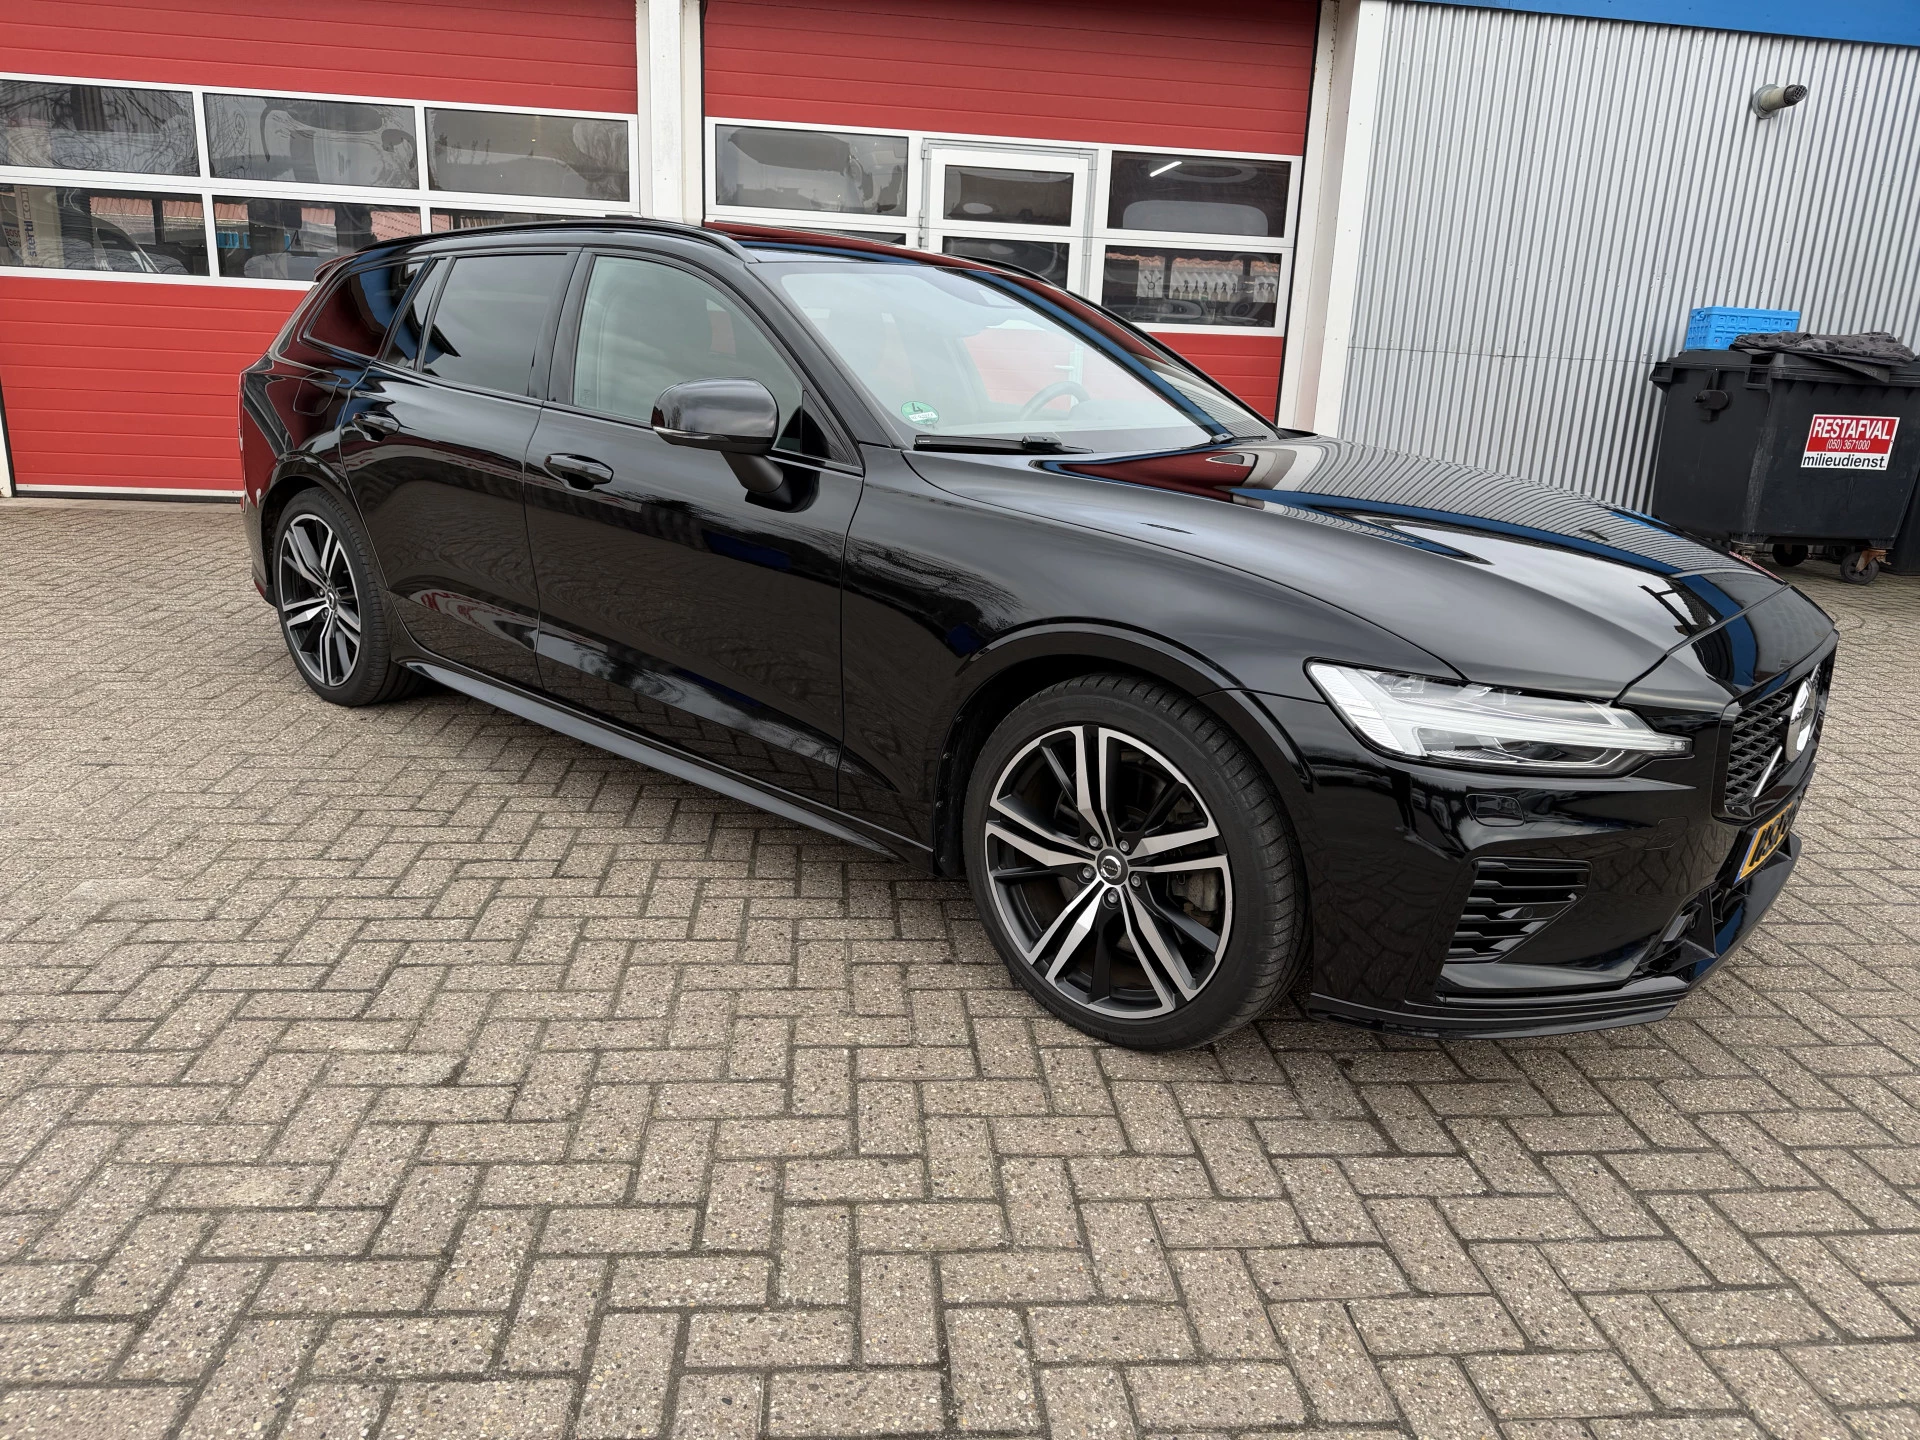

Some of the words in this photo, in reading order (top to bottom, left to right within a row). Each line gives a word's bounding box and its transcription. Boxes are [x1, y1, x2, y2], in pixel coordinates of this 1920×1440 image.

[24, 221, 37, 257] stertil
[912, 403, 923, 413] 4
[1812, 419, 1890, 439] RESTAFVAL
[1826, 439, 1842, 451] (050)
[1843, 440, 1870, 450] 3671000
